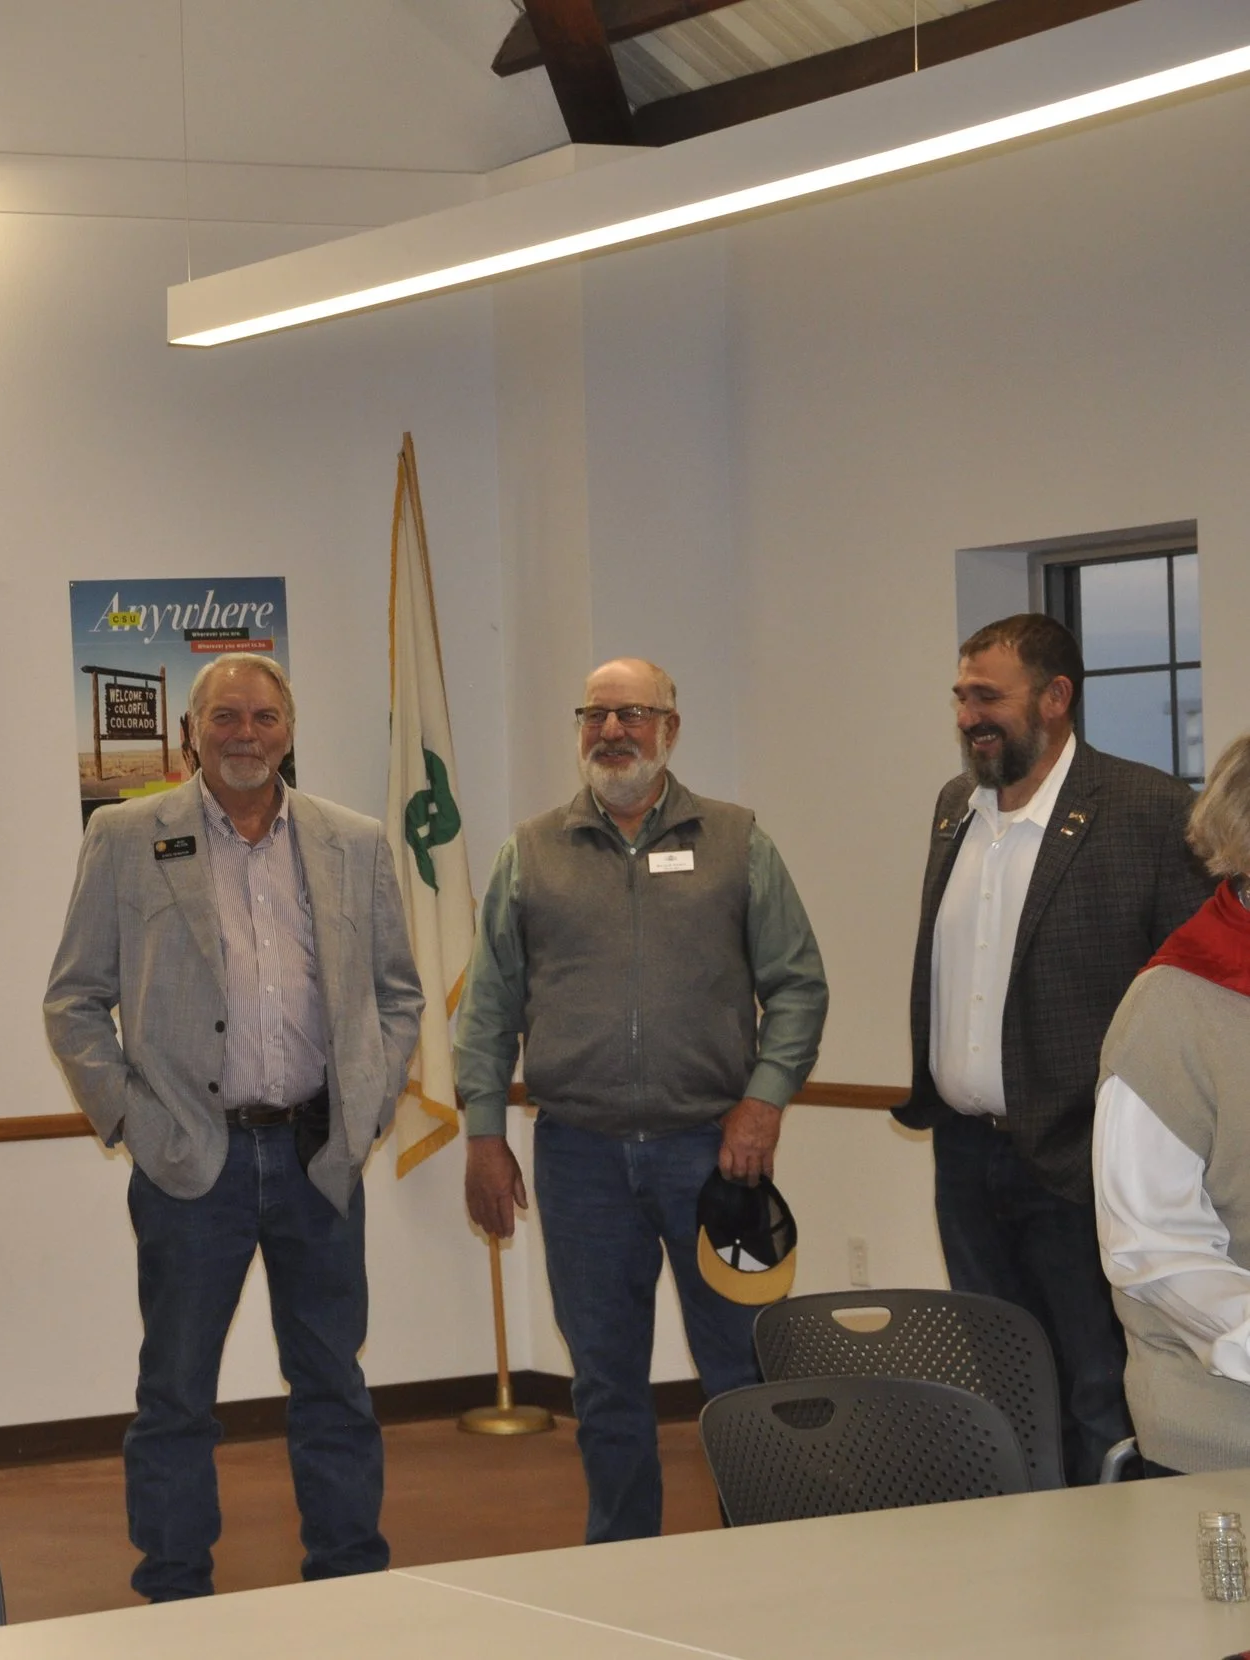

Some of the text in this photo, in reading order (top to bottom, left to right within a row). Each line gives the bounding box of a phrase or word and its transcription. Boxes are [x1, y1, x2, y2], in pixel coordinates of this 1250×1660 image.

[88, 590, 274, 644] Anywhere
[110, 688, 154, 703] WELCOME TO
[114, 702, 150, 716] COLORFUL
[110, 717, 155, 729] COLORADO
